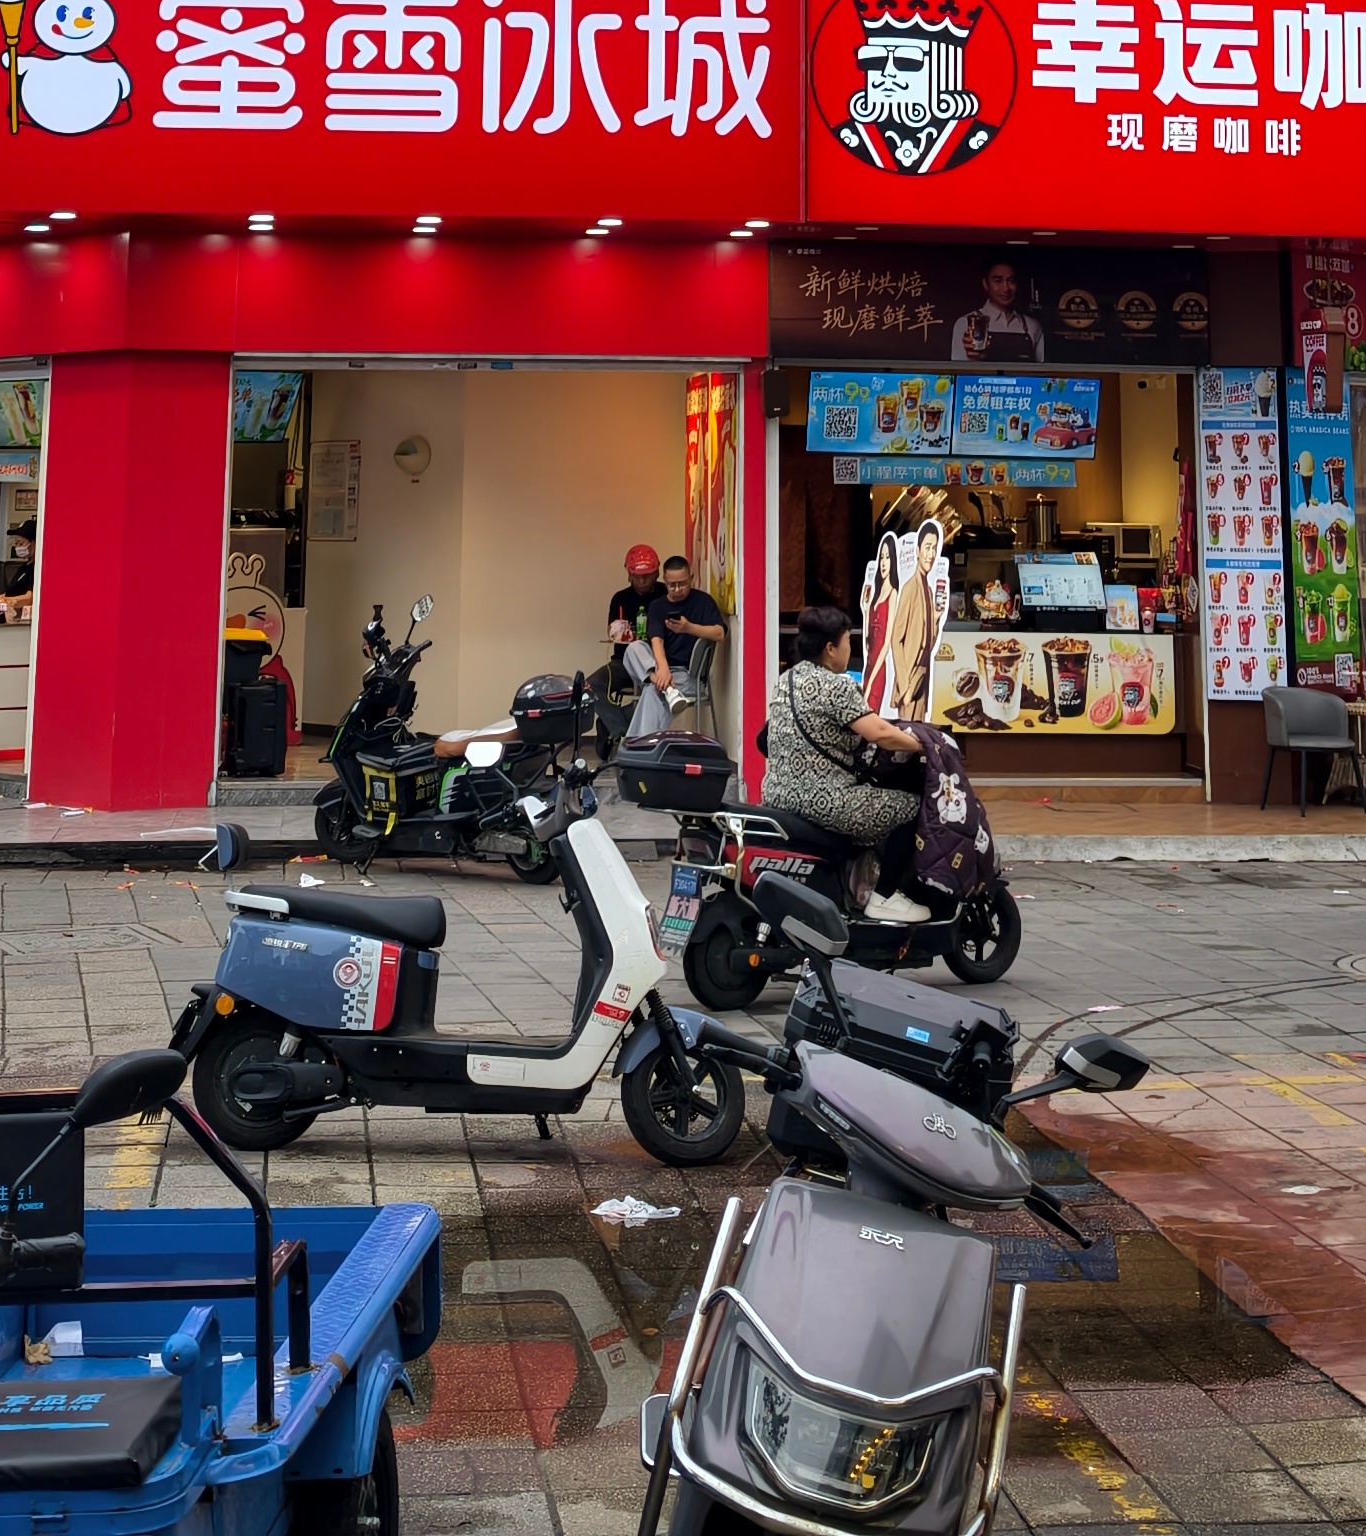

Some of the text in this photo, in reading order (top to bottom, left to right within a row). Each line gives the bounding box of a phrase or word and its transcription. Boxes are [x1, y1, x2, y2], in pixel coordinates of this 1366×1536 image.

[1106, 113, 1302, 157] 现磨咖啡
[799, 266, 928, 304] 新鲜烘焙
[821, 304, 943, 343] 现磨鲜萃
[1347, 307, 1359, 335] 8
[962, 396, 1032, 412] 免费租车权
[861, 465, 938, 480] 小程序下单
